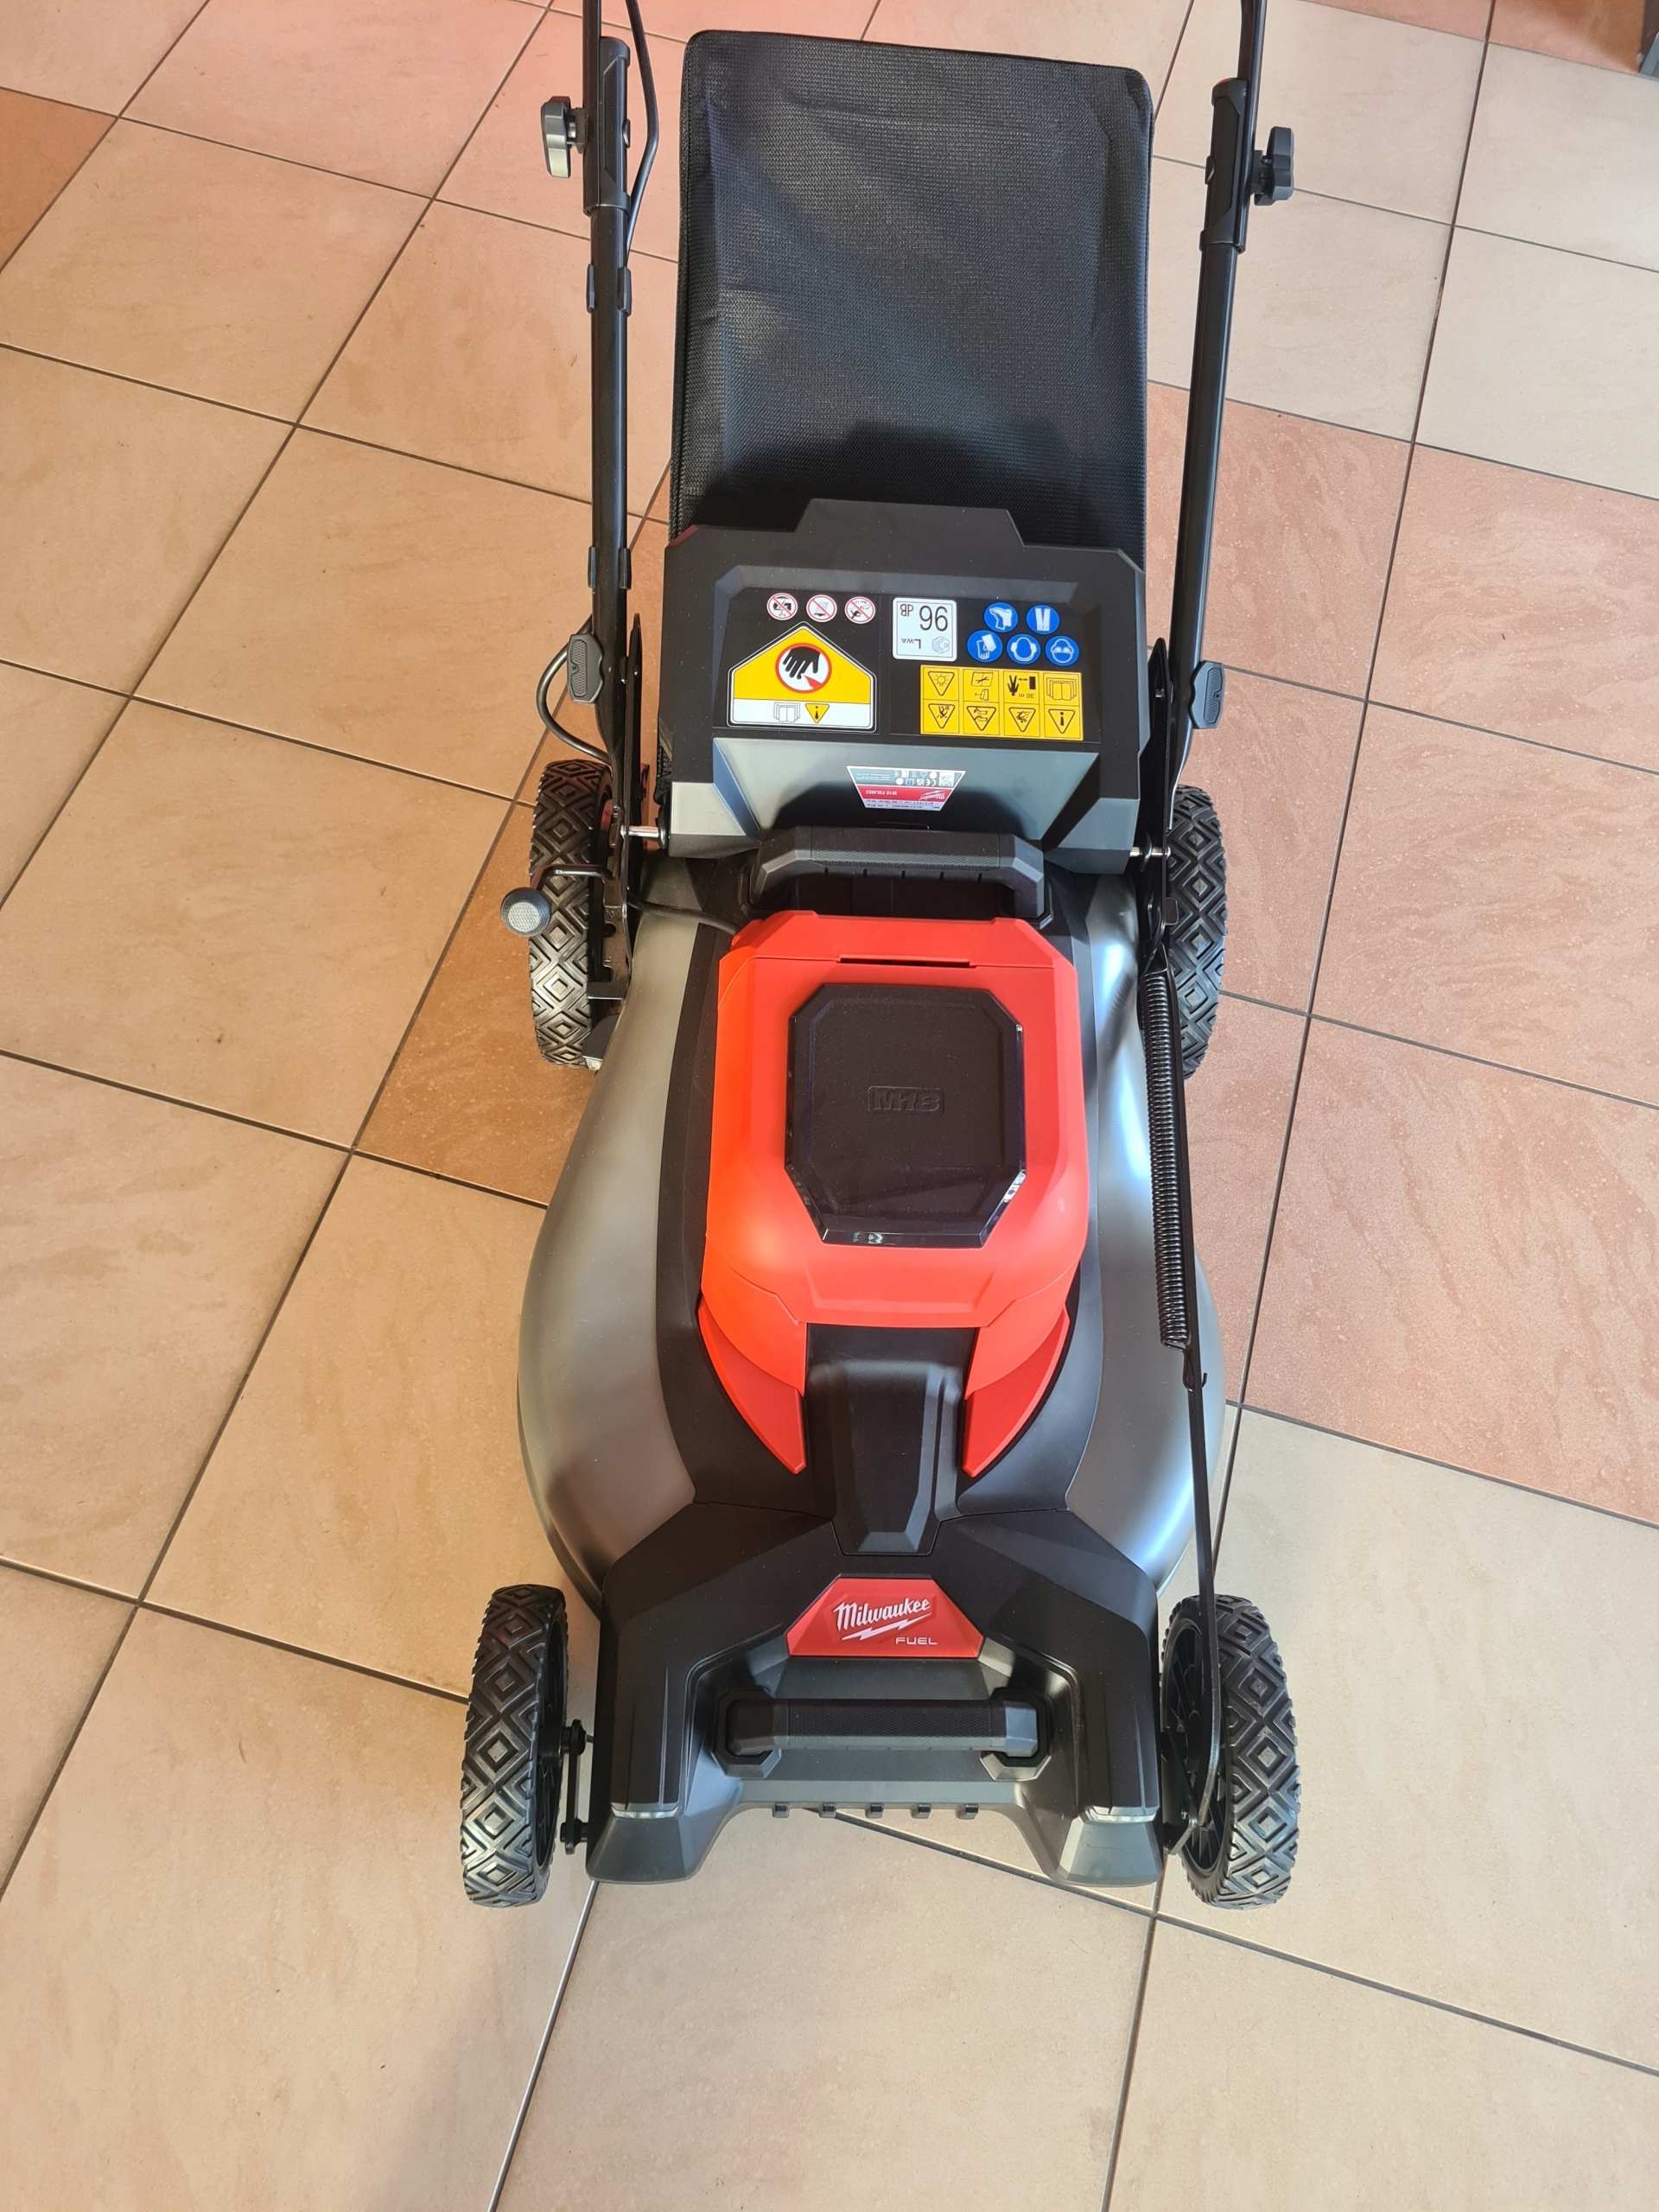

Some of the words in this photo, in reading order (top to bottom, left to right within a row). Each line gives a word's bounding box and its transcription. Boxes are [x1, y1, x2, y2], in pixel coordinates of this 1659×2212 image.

[899, 603, 914, 617] dB
[918, 605, 949, 632] 96
[872, 1090, 940, 1112] M18
[833, 1598, 931, 1632] Milwaukee
[895, 1636, 938, 1645] FUEL
